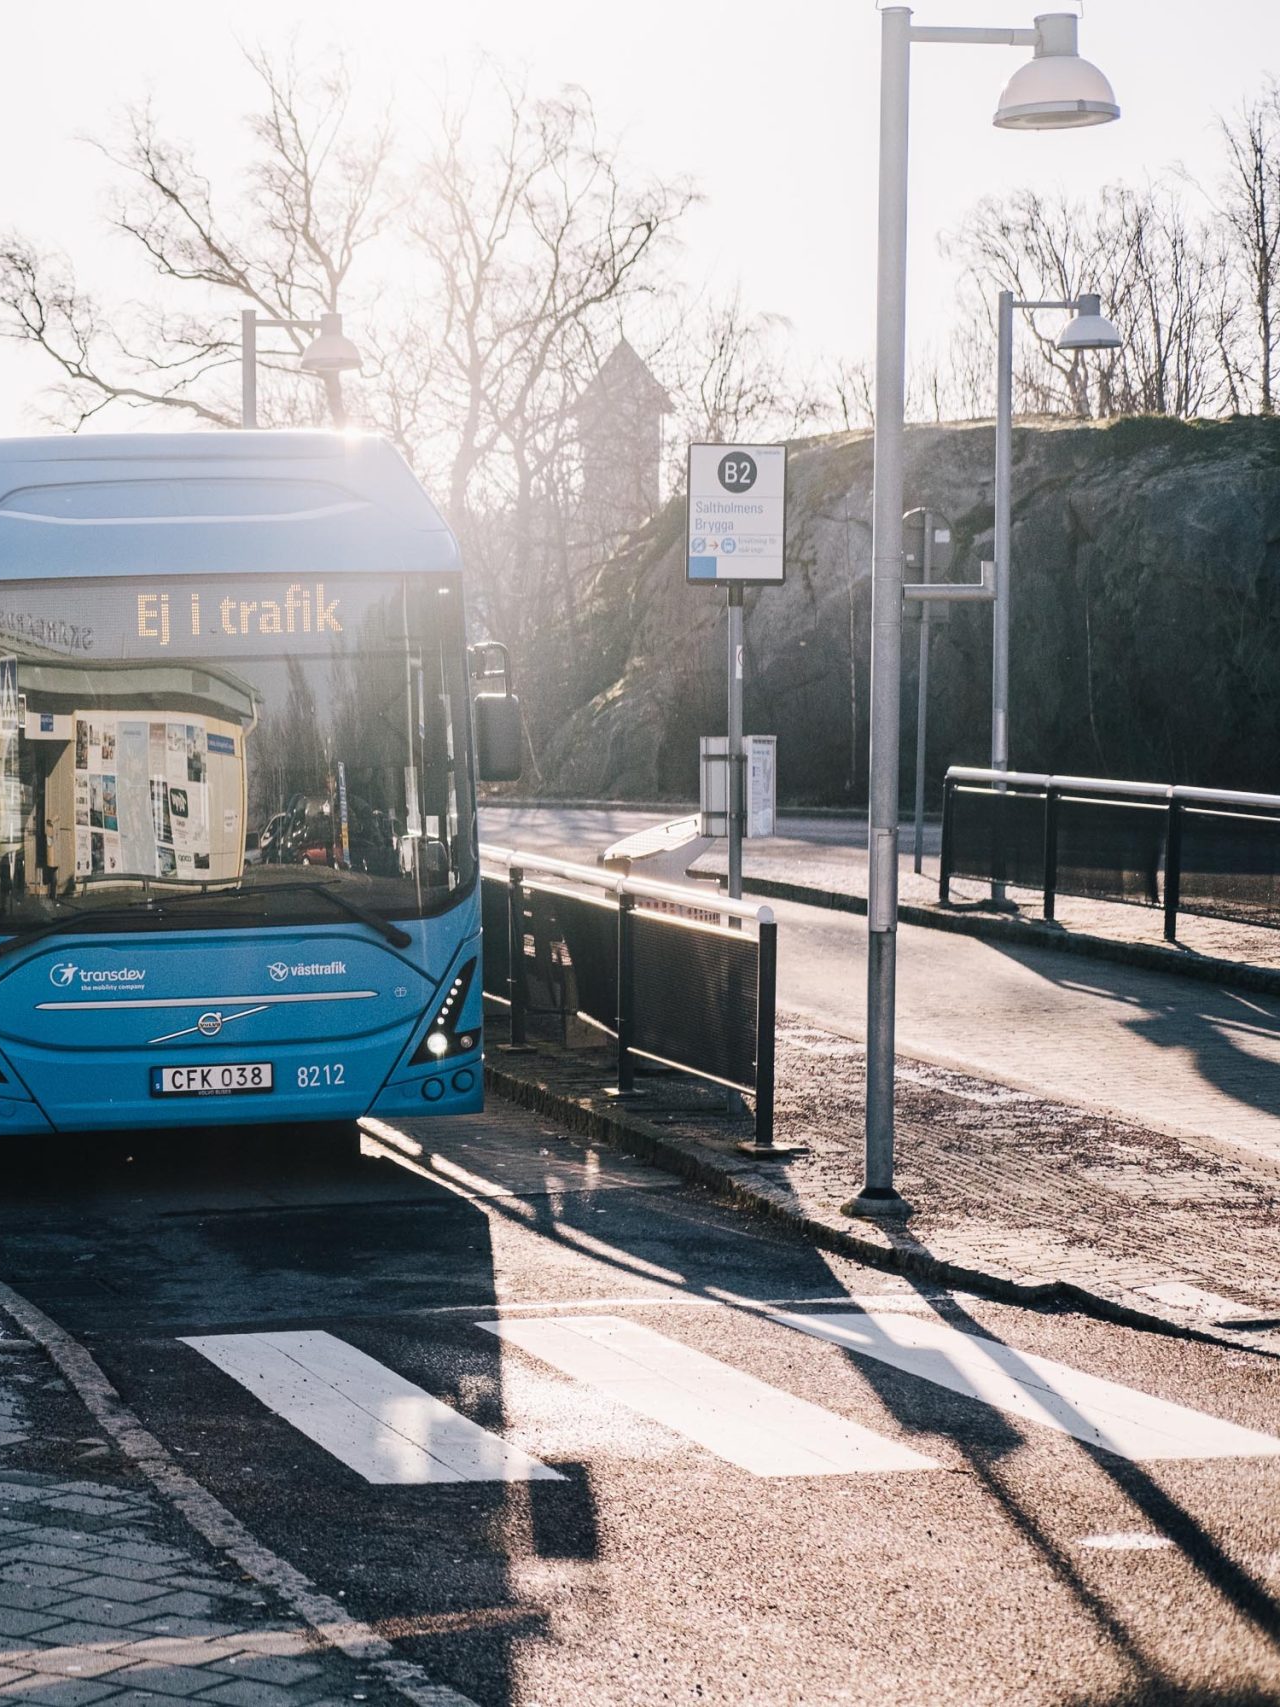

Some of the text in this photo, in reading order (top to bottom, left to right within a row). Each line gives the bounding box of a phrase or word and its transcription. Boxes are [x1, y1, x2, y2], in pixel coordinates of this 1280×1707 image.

[724, 461, 752, 484] B2
[695, 501, 764, 515] Saltholmens
[695, 517, 734, 533] Brygga
[137, 583, 344, 645] Ej i trafik
[78, 967, 146, 982] transdev
[290, 961, 347, 977] västtrafik
[92, 984, 118, 992] mobility
[118, 983, 145, 992] company
[171, 1066, 264, 1090] CFK 038
[297, 1063, 345, 1088] 8212
